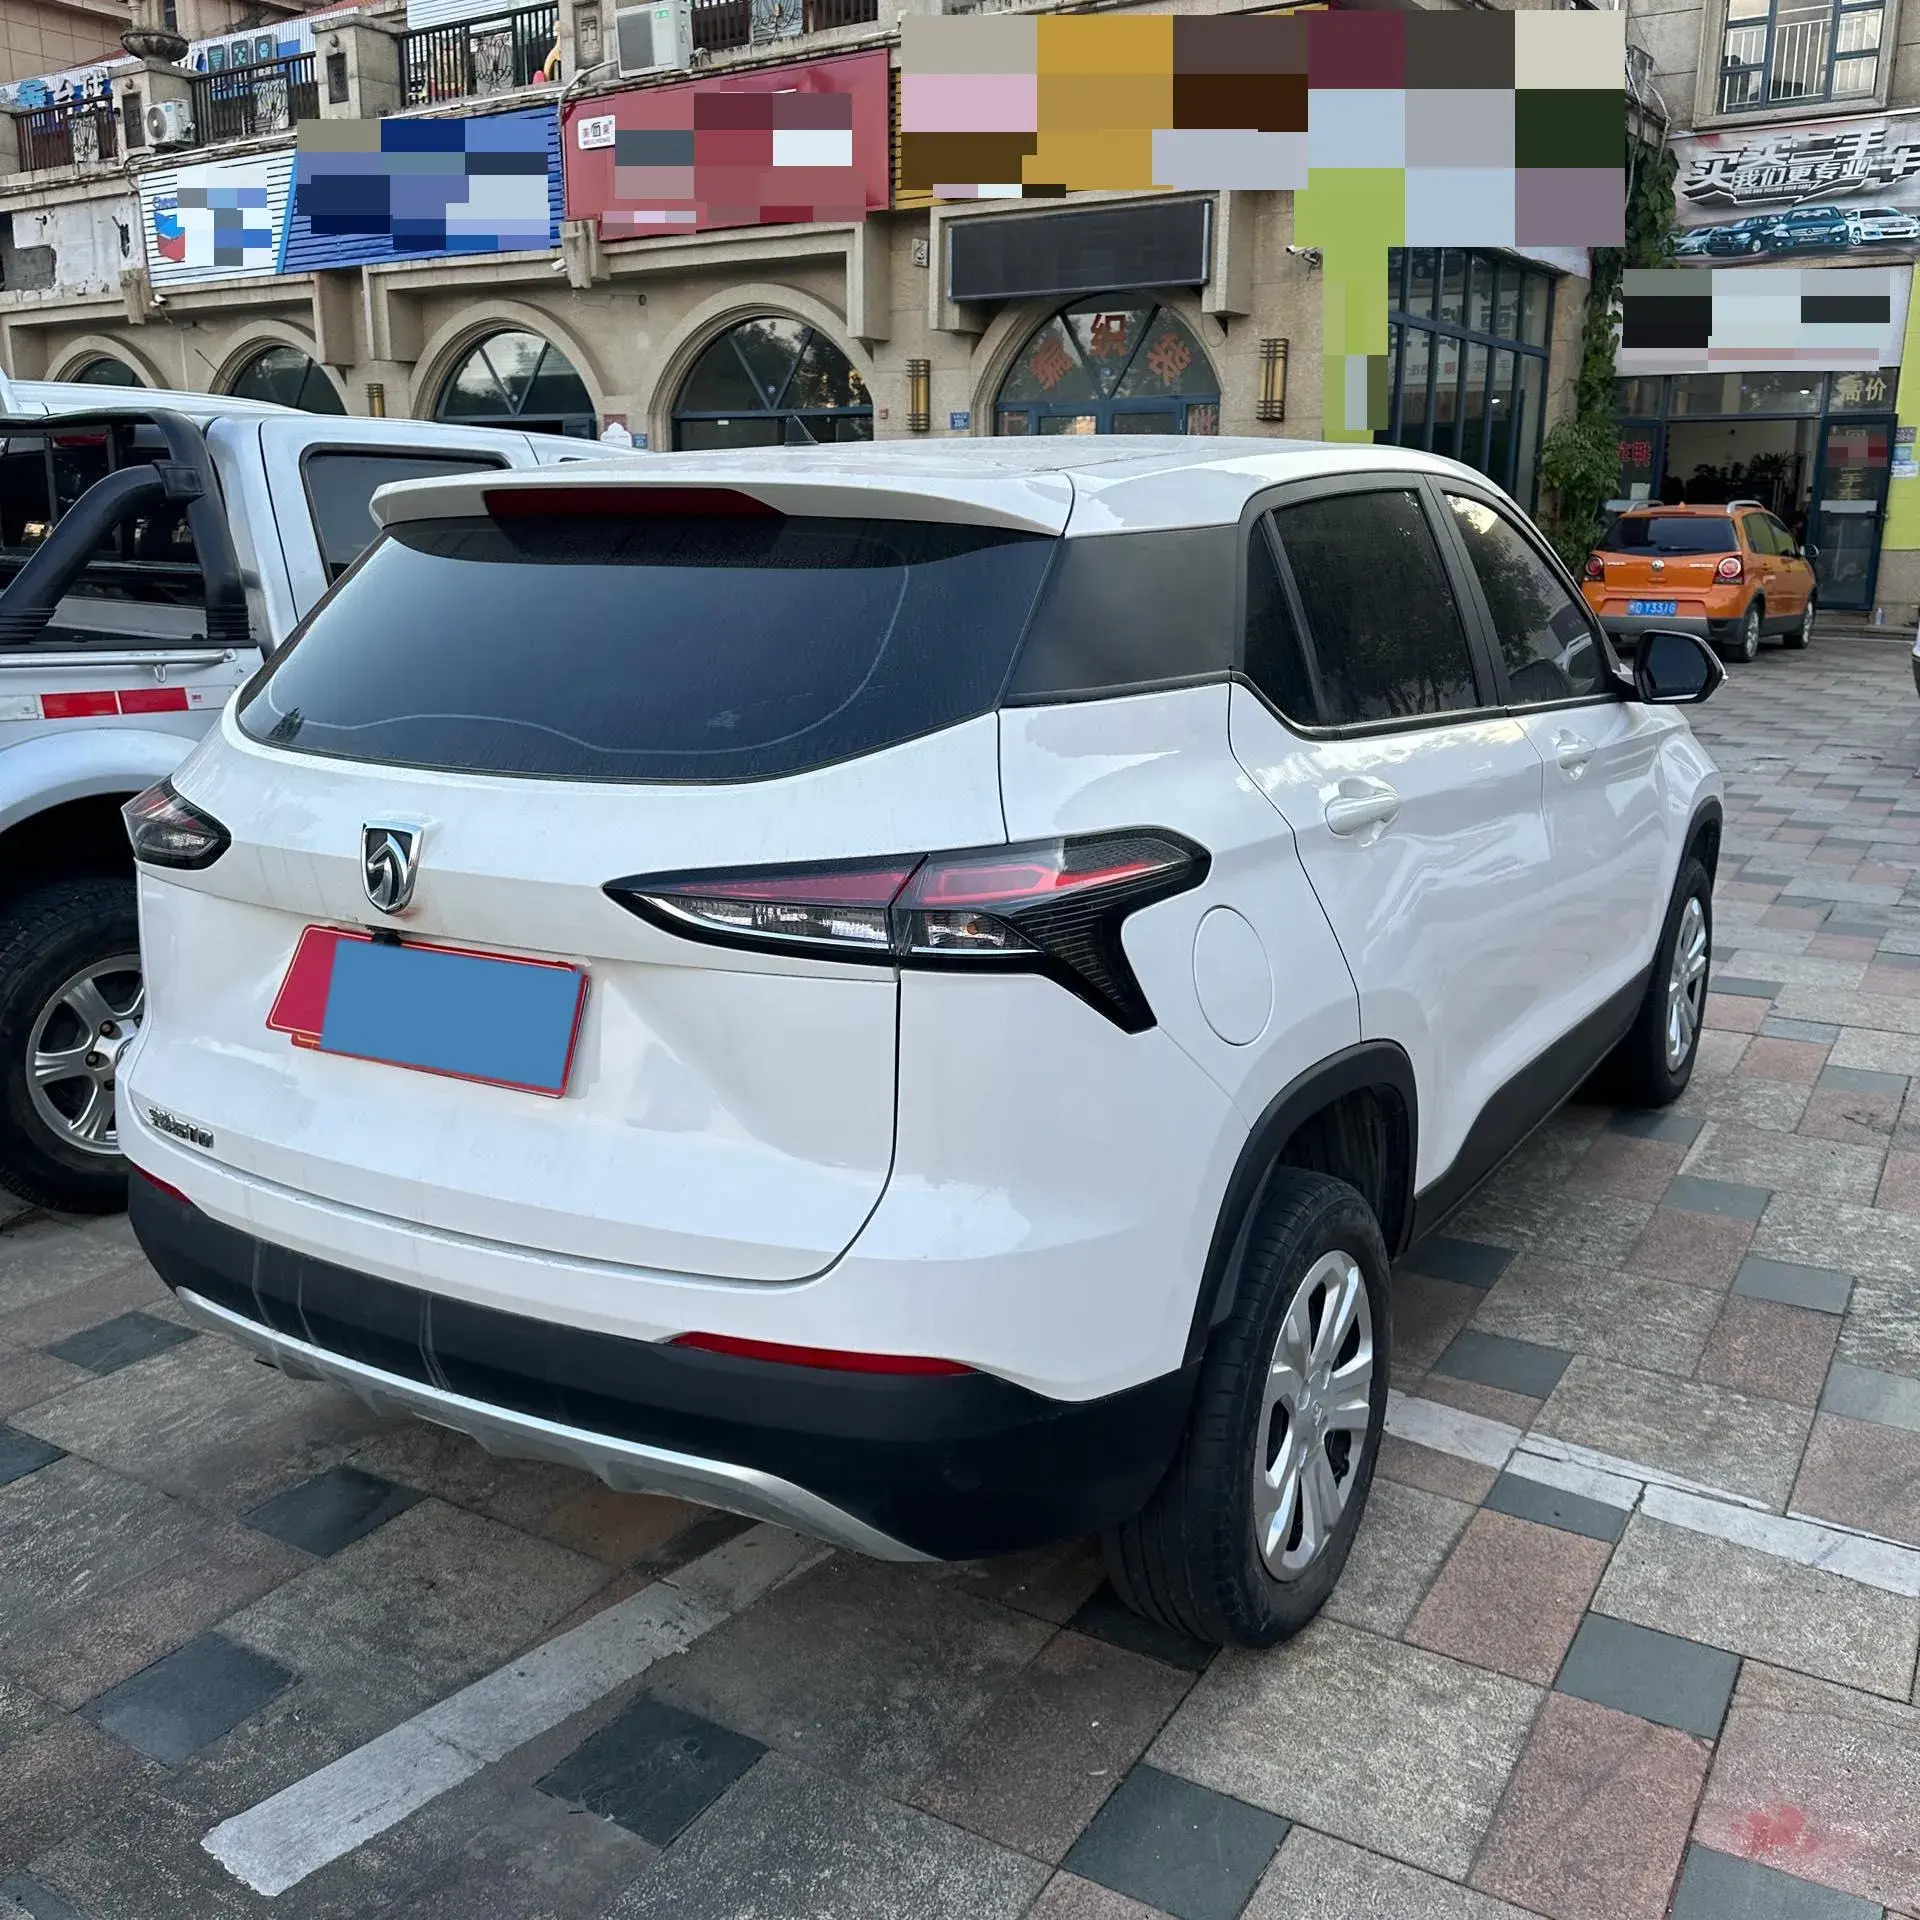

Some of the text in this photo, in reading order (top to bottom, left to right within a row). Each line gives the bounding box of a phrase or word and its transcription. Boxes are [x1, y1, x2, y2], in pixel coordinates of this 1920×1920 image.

[1684, 131, 1920, 192] 买卖二手车
[1733, 159, 1869, 190] 我们更专业
